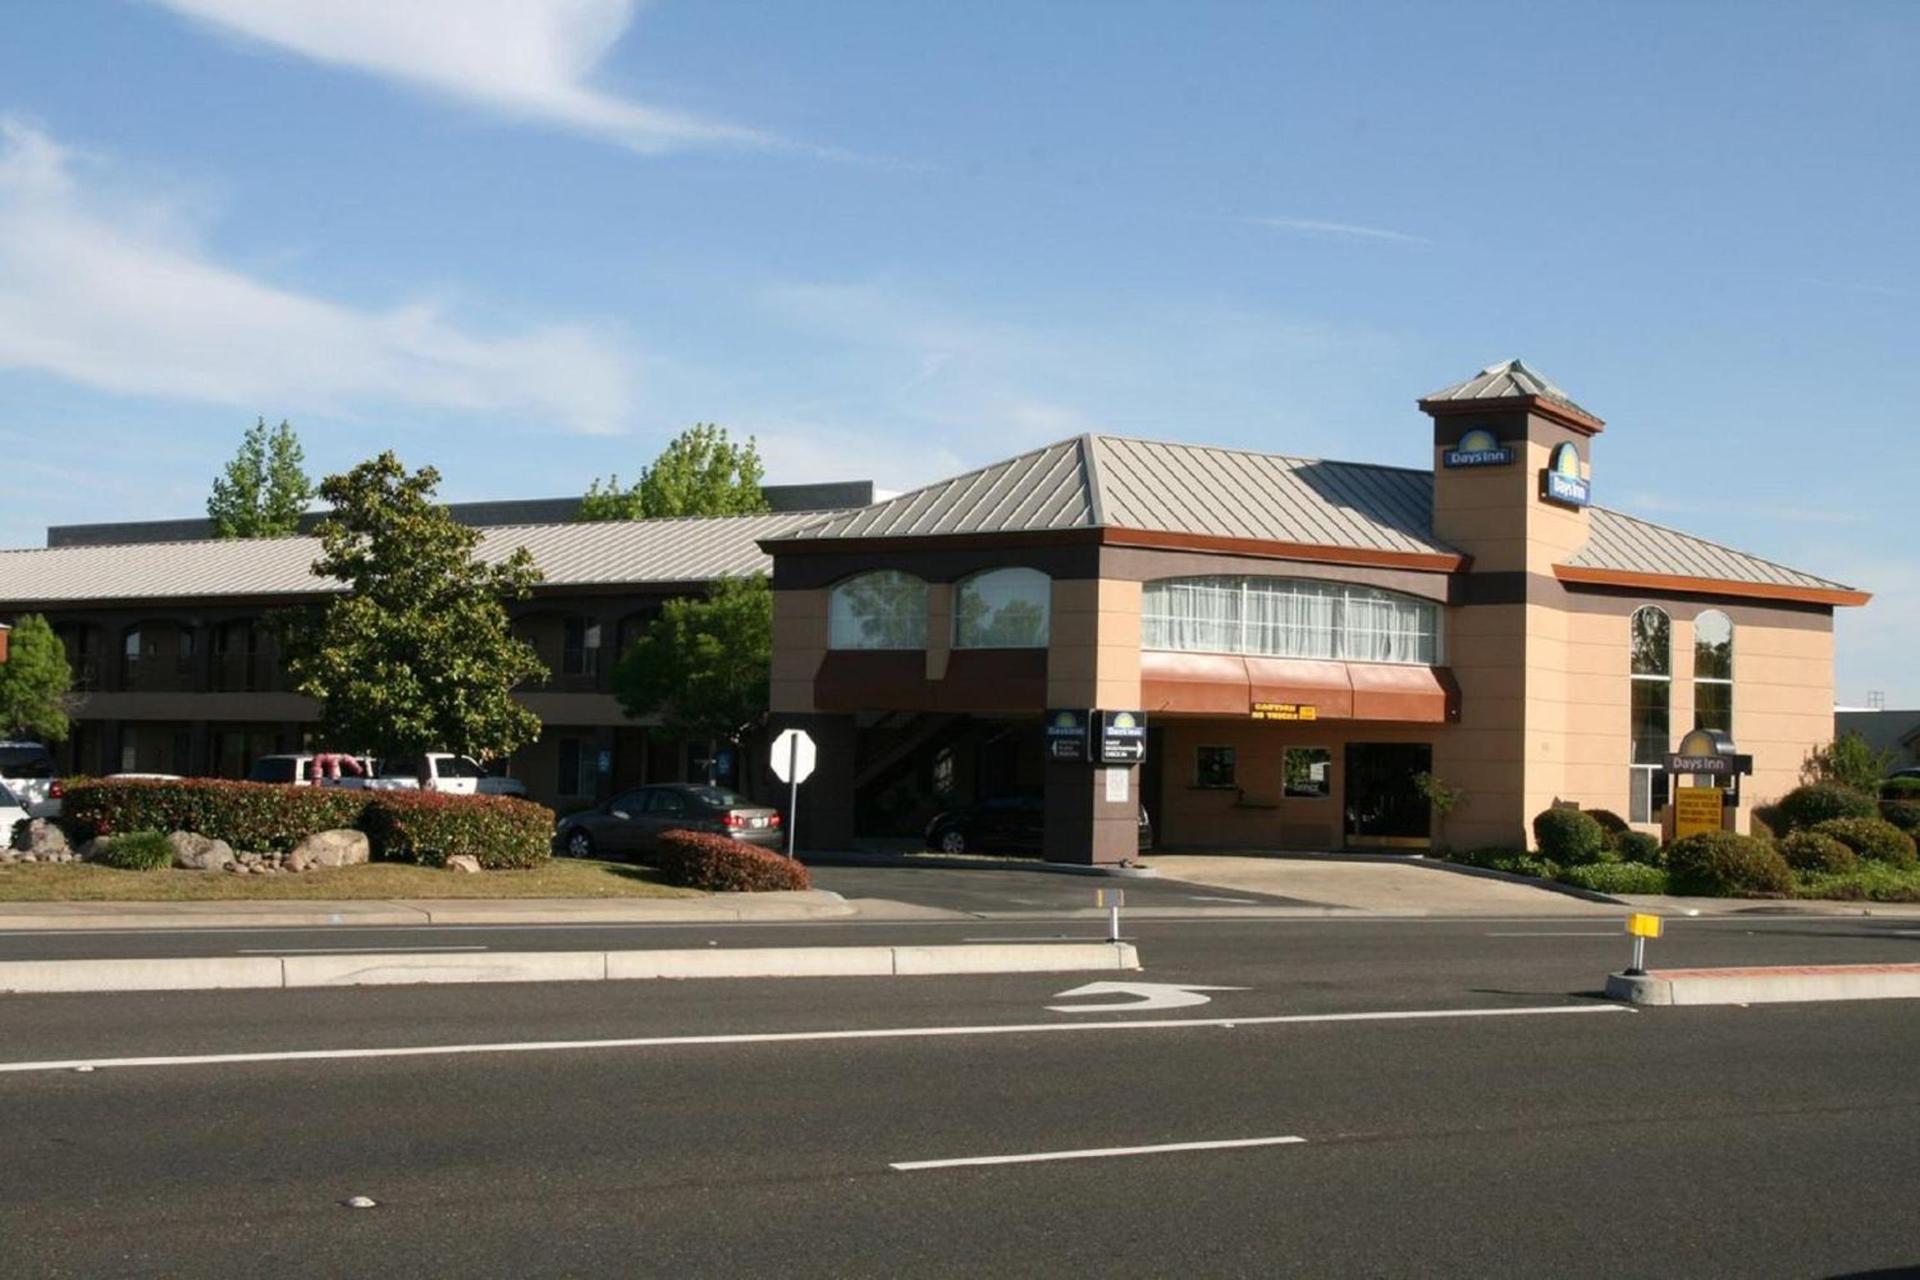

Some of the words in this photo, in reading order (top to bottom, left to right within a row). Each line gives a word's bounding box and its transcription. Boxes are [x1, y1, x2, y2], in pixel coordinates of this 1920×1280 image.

[1451, 452, 1481, 464] Days
[1483, 451, 1504, 461] Inn
[1673, 757, 1703, 772] Days
[1704, 758, 1725, 770] Inn
